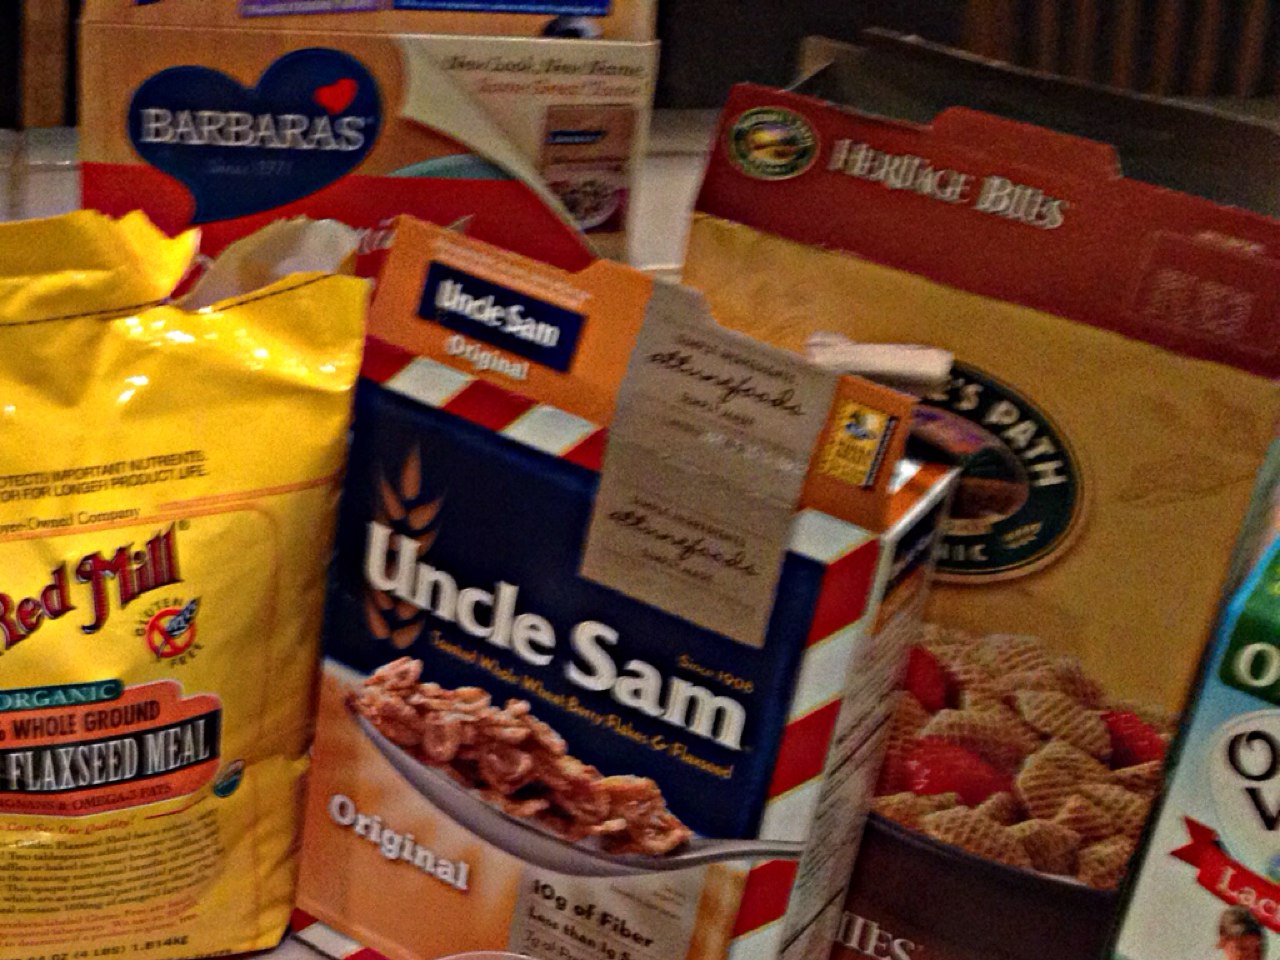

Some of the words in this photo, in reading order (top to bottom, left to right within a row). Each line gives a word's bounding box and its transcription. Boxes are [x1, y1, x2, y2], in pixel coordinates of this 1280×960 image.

[435, 279, 505, 327] Uncle
[500, 305, 561, 347] Sam
[445, 333, 529, 380] Original
[982, 400, 1068, 487] PATH
[110, 468, 174, 489] PRODUCT
[75, 519, 184, 636] Mill
[134, 597, 185, 637] GLUTEN
[364, 519, 558, 667] Uncle
[563, 619, 748, 752] Sam
[11, 713, 77, 739] WHOLE
[83, 699, 161, 733] GROUND
[10, 737, 140, 791] FLAXSEED
[144, 719, 211, 776] MEAL
[327, 793, 470, 892] Original
[527, 905, 560, 931] Less
[562, 923, 597, 950] than
[532, 878, 568, 912] 10g
[573, 903, 597, 921] of
[598, 911, 655, 949] Fiber
